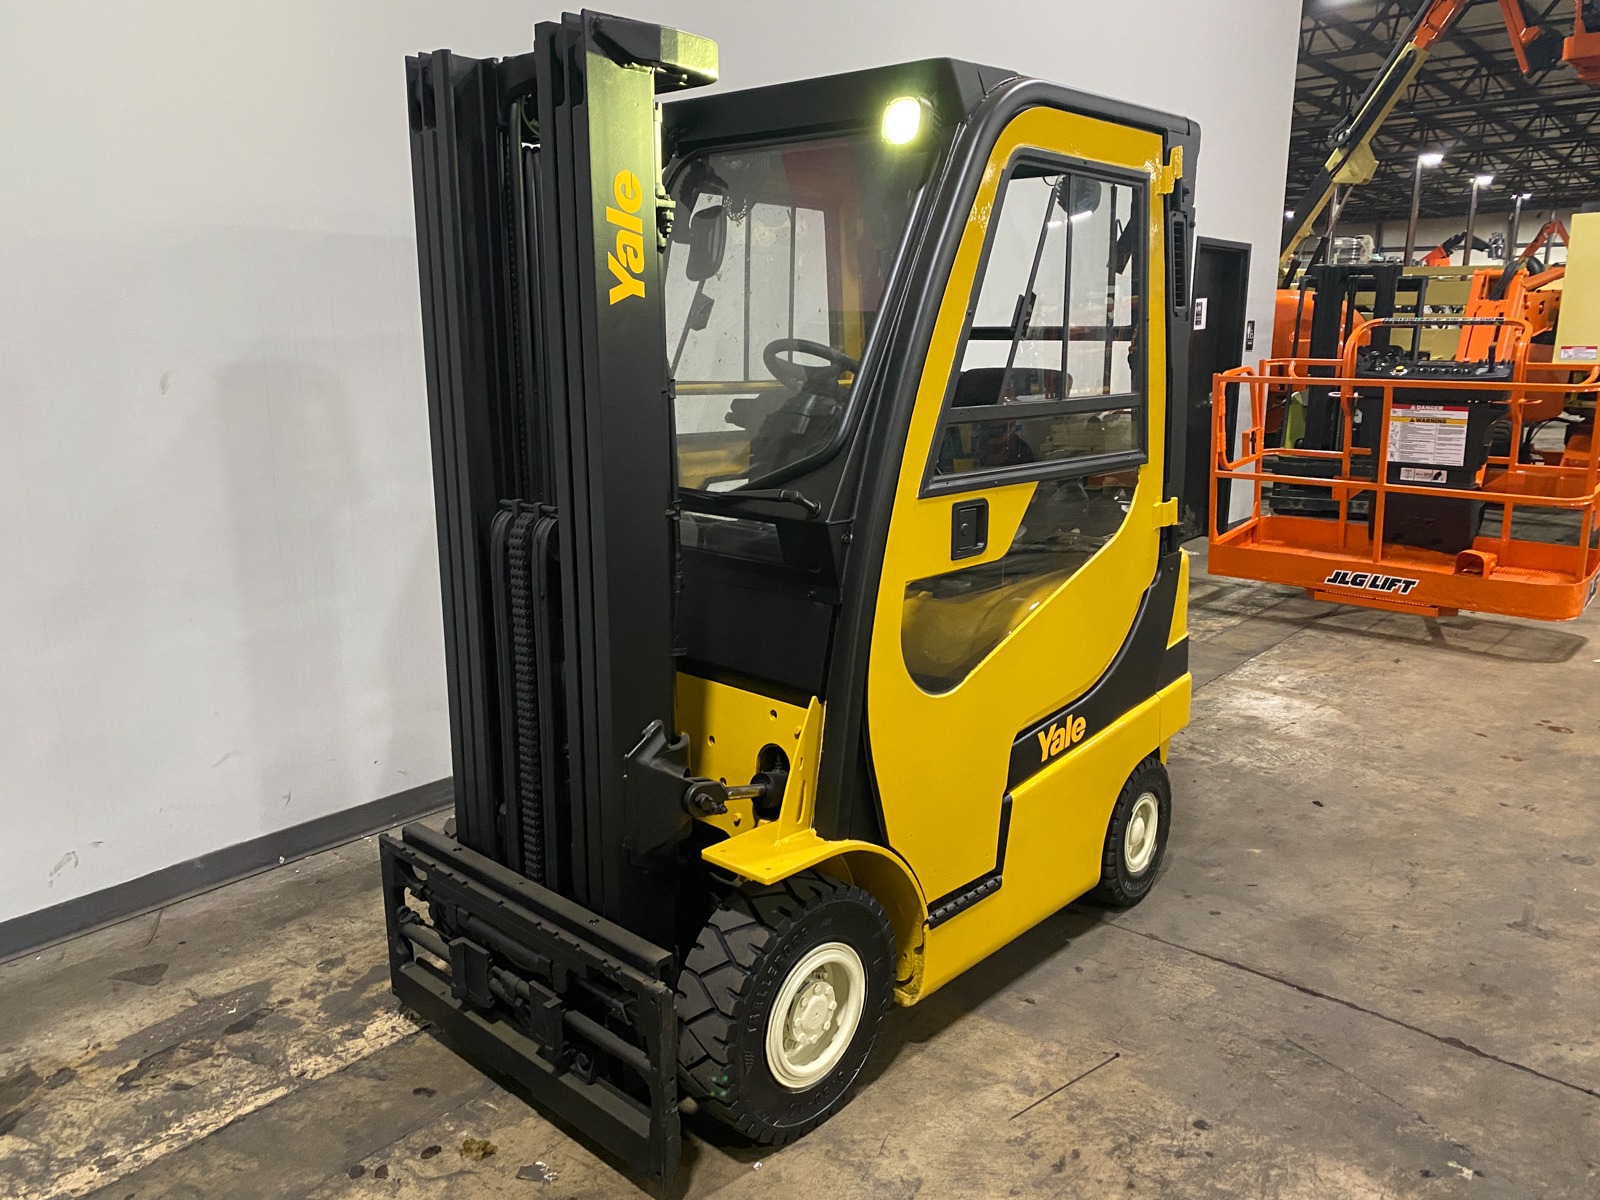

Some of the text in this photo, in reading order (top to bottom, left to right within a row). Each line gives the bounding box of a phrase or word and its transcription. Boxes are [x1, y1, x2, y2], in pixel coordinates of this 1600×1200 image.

[605, 169, 646, 306] Yale
[1325, 570, 1418, 594] JLG LIFT
[1037, 713, 1087, 763] Yale
